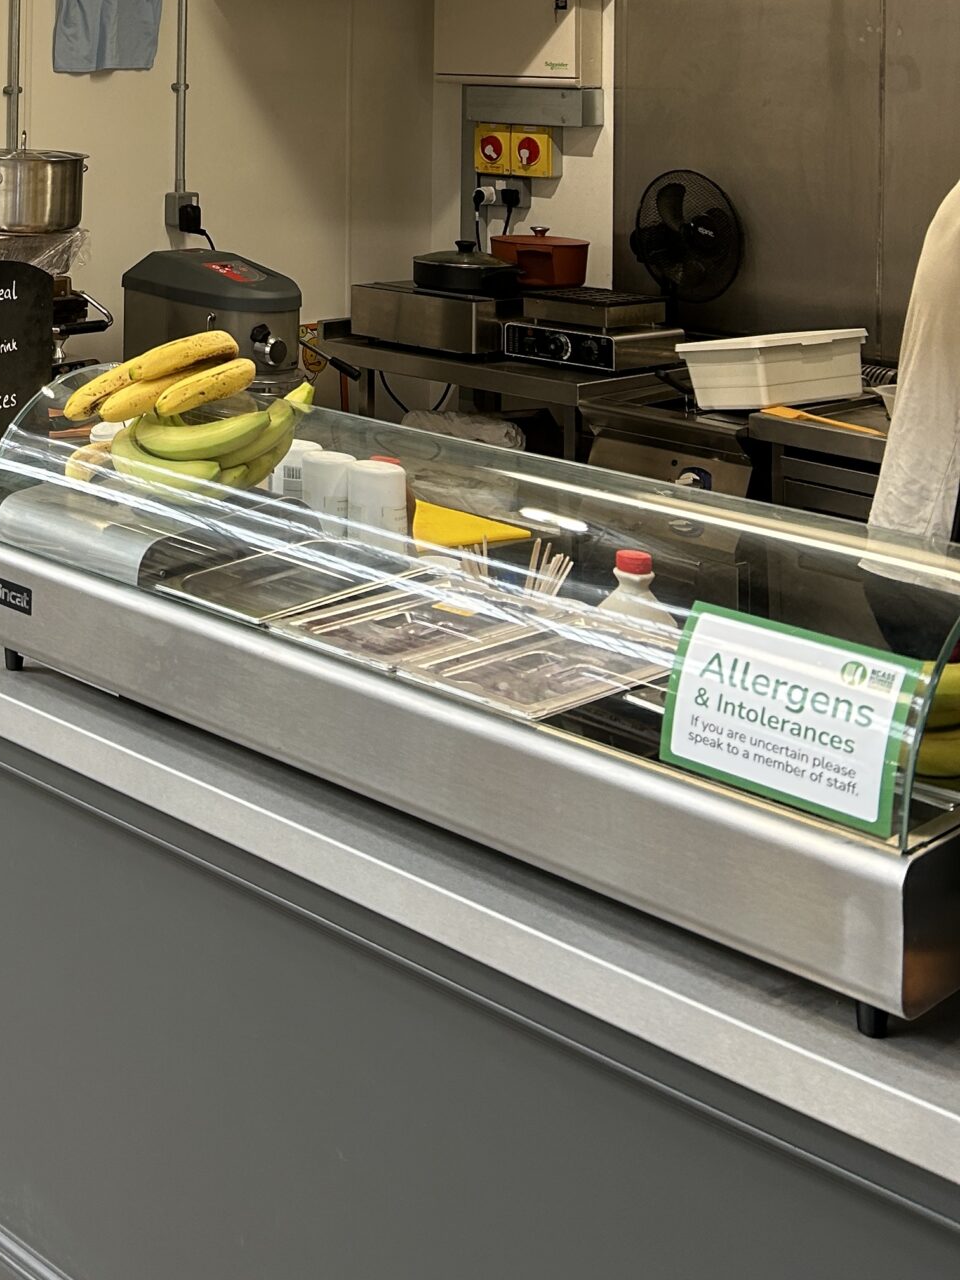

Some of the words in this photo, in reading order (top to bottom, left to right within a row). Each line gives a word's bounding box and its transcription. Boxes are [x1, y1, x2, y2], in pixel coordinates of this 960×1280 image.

[694, 687, 710, 709] &
[716, 694, 855, 754] Intolerances
[699, 652, 874, 727] Allergens
[688, 730, 724, 751] speak
[727, 742, 740, 756] to
[742, 748, 749, 759] a
[753, 753, 806, 778] member
[809, 771, 824, 784] of
[826, 777, 859, 797] staff.
[690, 714, 700, 727] If
[702, 719, 723, 736] you
[727, 728, 747, 743] are
[750, 736, 809, 763] uncertain
[812, 756, 857, 780] please
